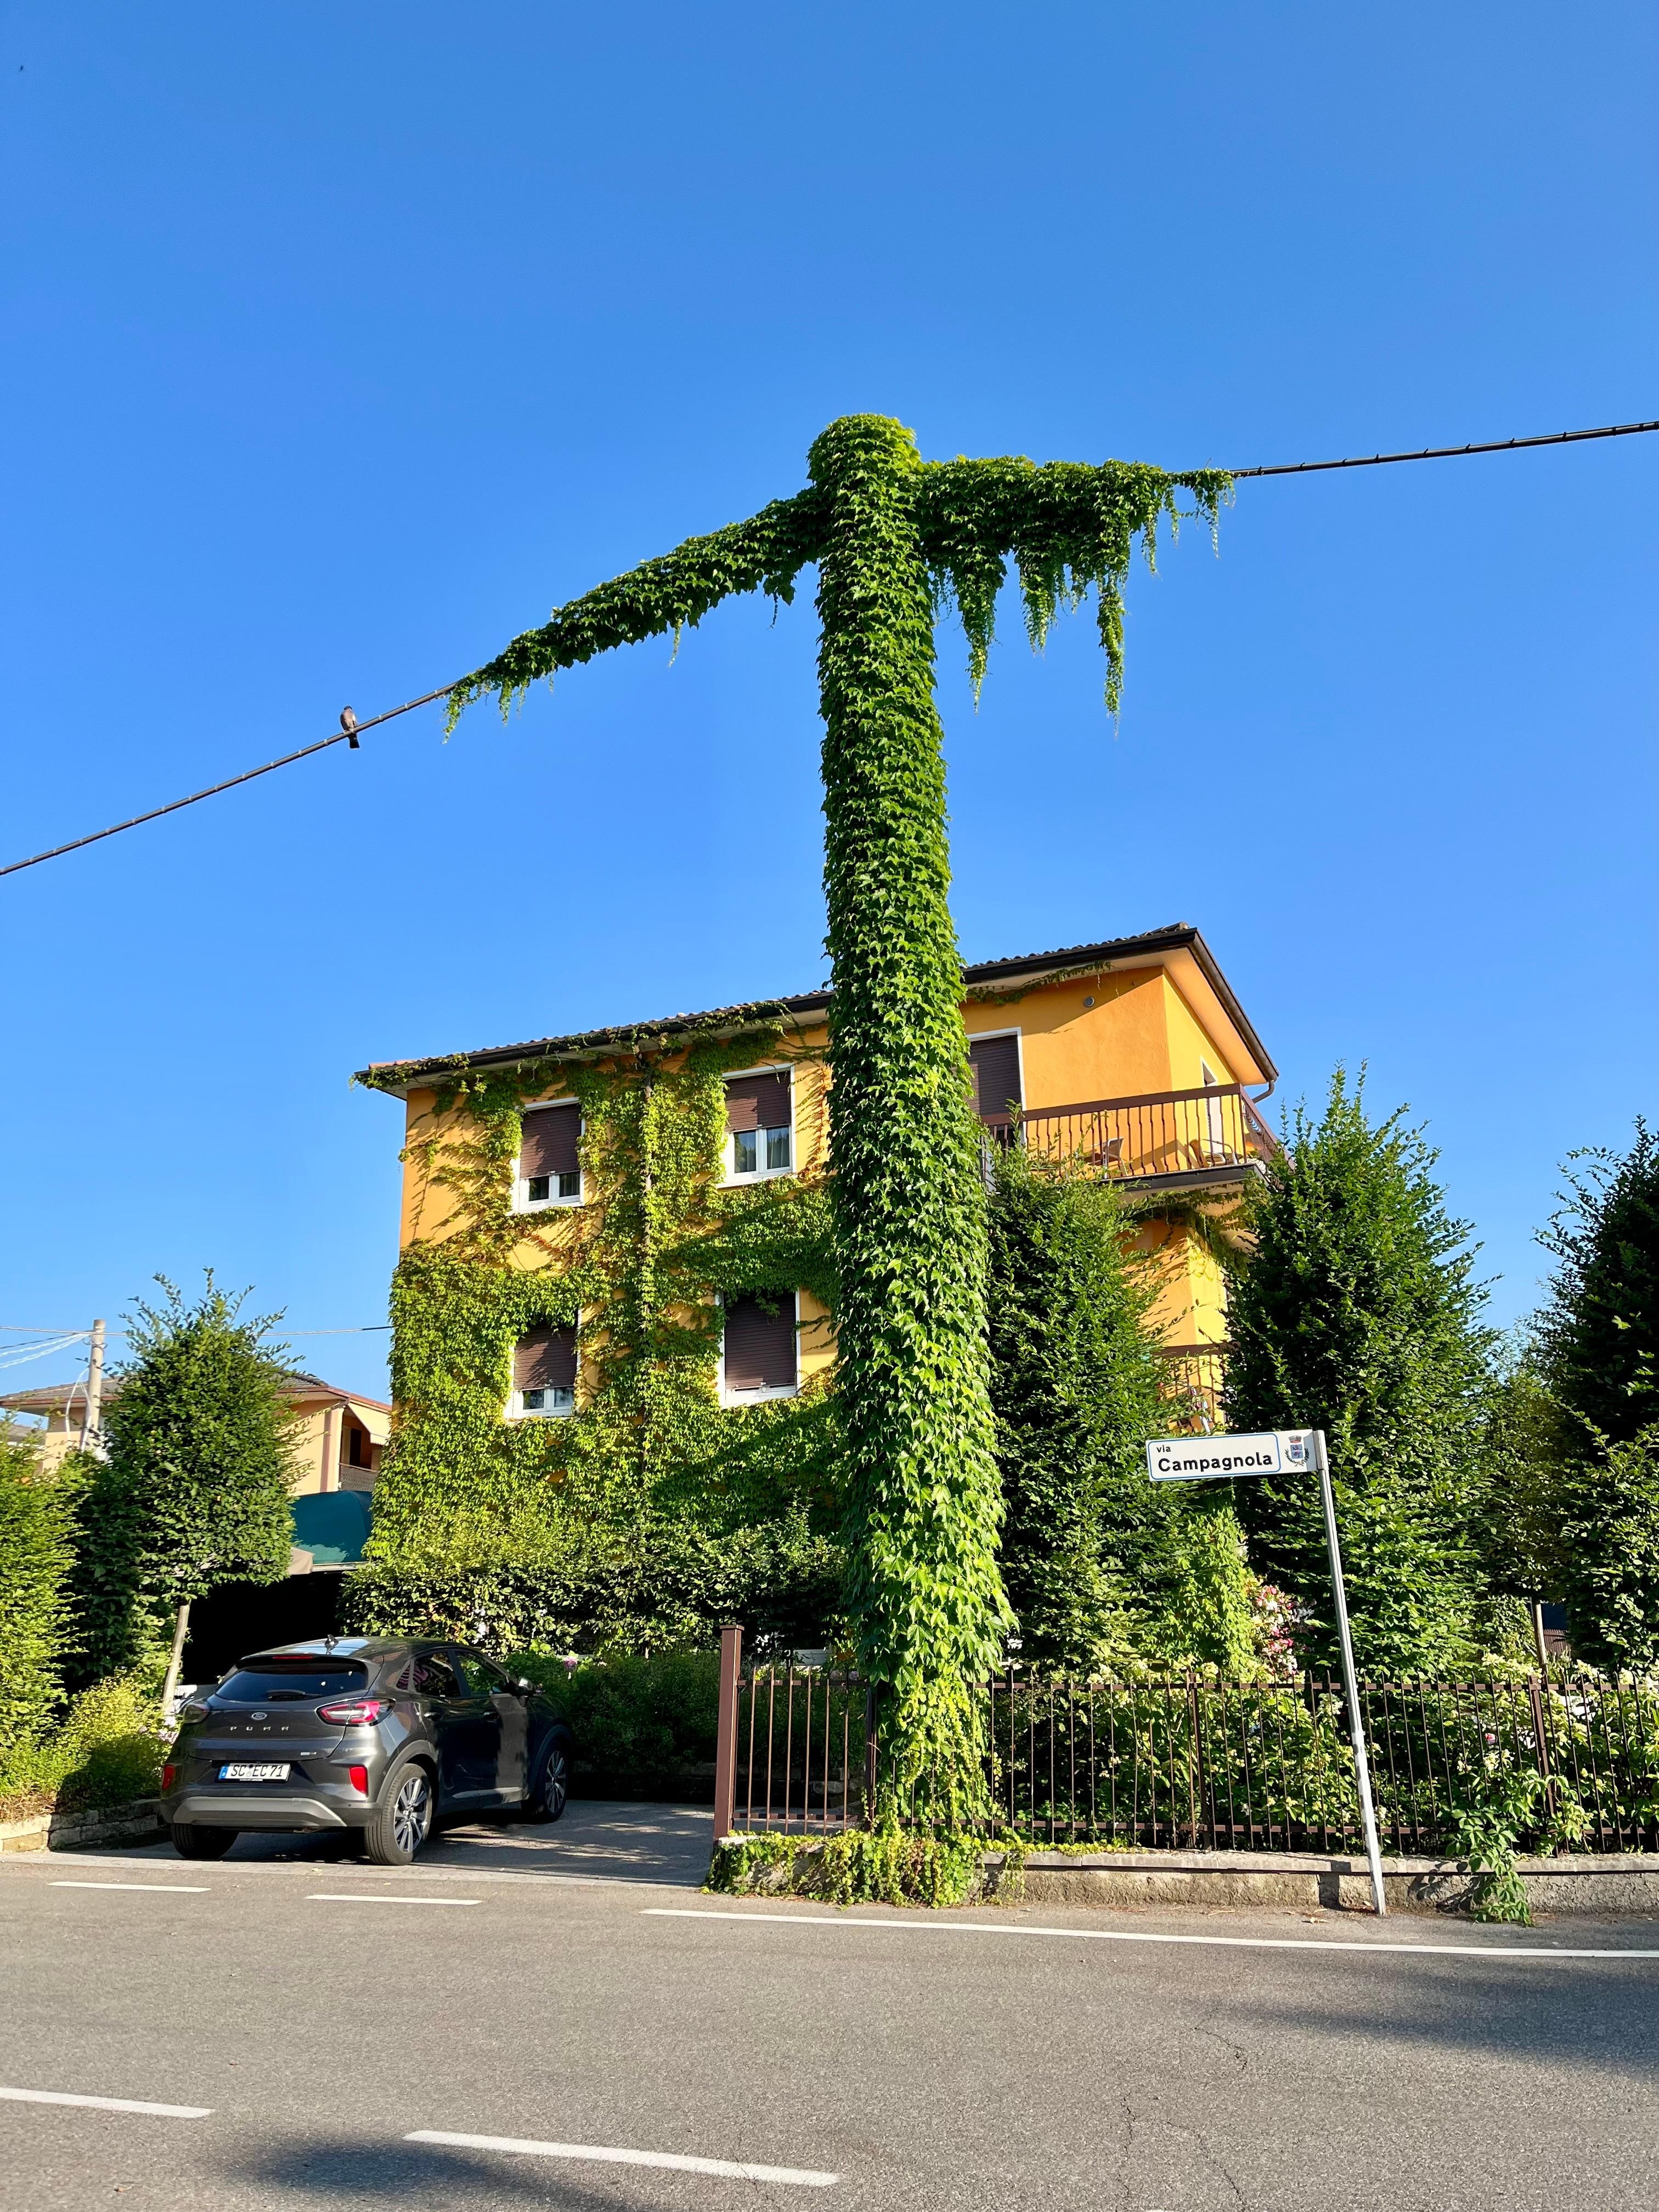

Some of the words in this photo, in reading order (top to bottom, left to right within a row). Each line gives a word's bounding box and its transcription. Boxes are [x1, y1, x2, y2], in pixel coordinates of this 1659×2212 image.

[1156, 1444, 1171, 1453] via
[1158, 1452, 1273, 1472] Campagnola
[231, 1764, 247, 1776] SC
[252, 1764, 268, 1777] EC
[269, 1764, 283, 1777] 71
